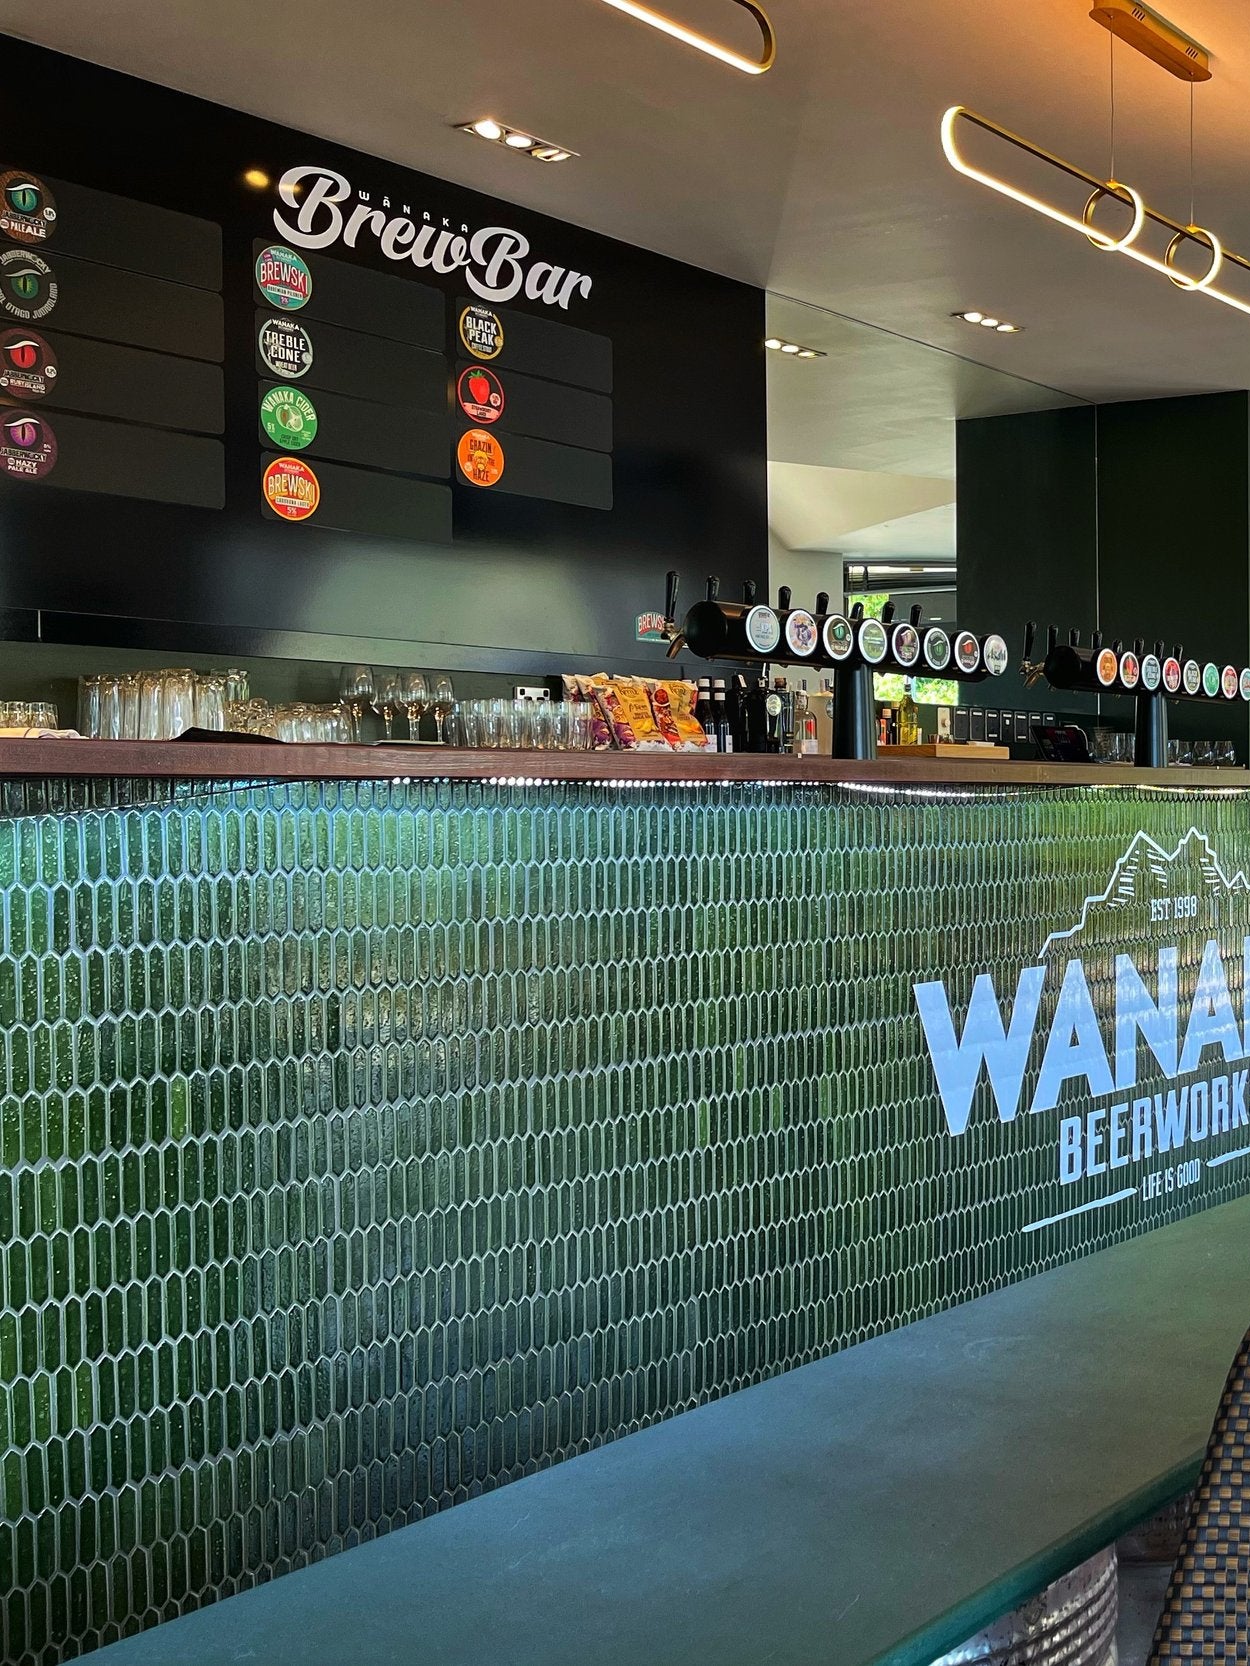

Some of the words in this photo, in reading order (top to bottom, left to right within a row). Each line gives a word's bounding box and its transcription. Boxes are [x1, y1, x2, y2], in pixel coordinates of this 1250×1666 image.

[260, 261, 308, 295] BREWSKI
[5, 302, 30, 319] OTAGO
[272, 319, 300, 330] WANAKA
[466, 316, 497, 336] BLACK
[265, 330, 306, 351] TREBLE
[469, 328, 494, 347] PEAK
[270, 345, 301, 363] CONE
[262, 391, 294, 412] WANAKA
[296, 396, 316, 421] CIDER
[16, 459, 37, 468] HAZY
[472, 469, 490, 482] HAZE
[268, 473, 316, 506] BREWSKI
[638, 613, 665, 633] BREWS
[1151, 898, 1170, 921] EST
[1174, 895, 1197, 918] 1998
[1143, 1169, 1162, 1202] LIFE
[1164, 1168, 1174, 1194] IS
[1176, 1158, 1201, 1189] GOOD
